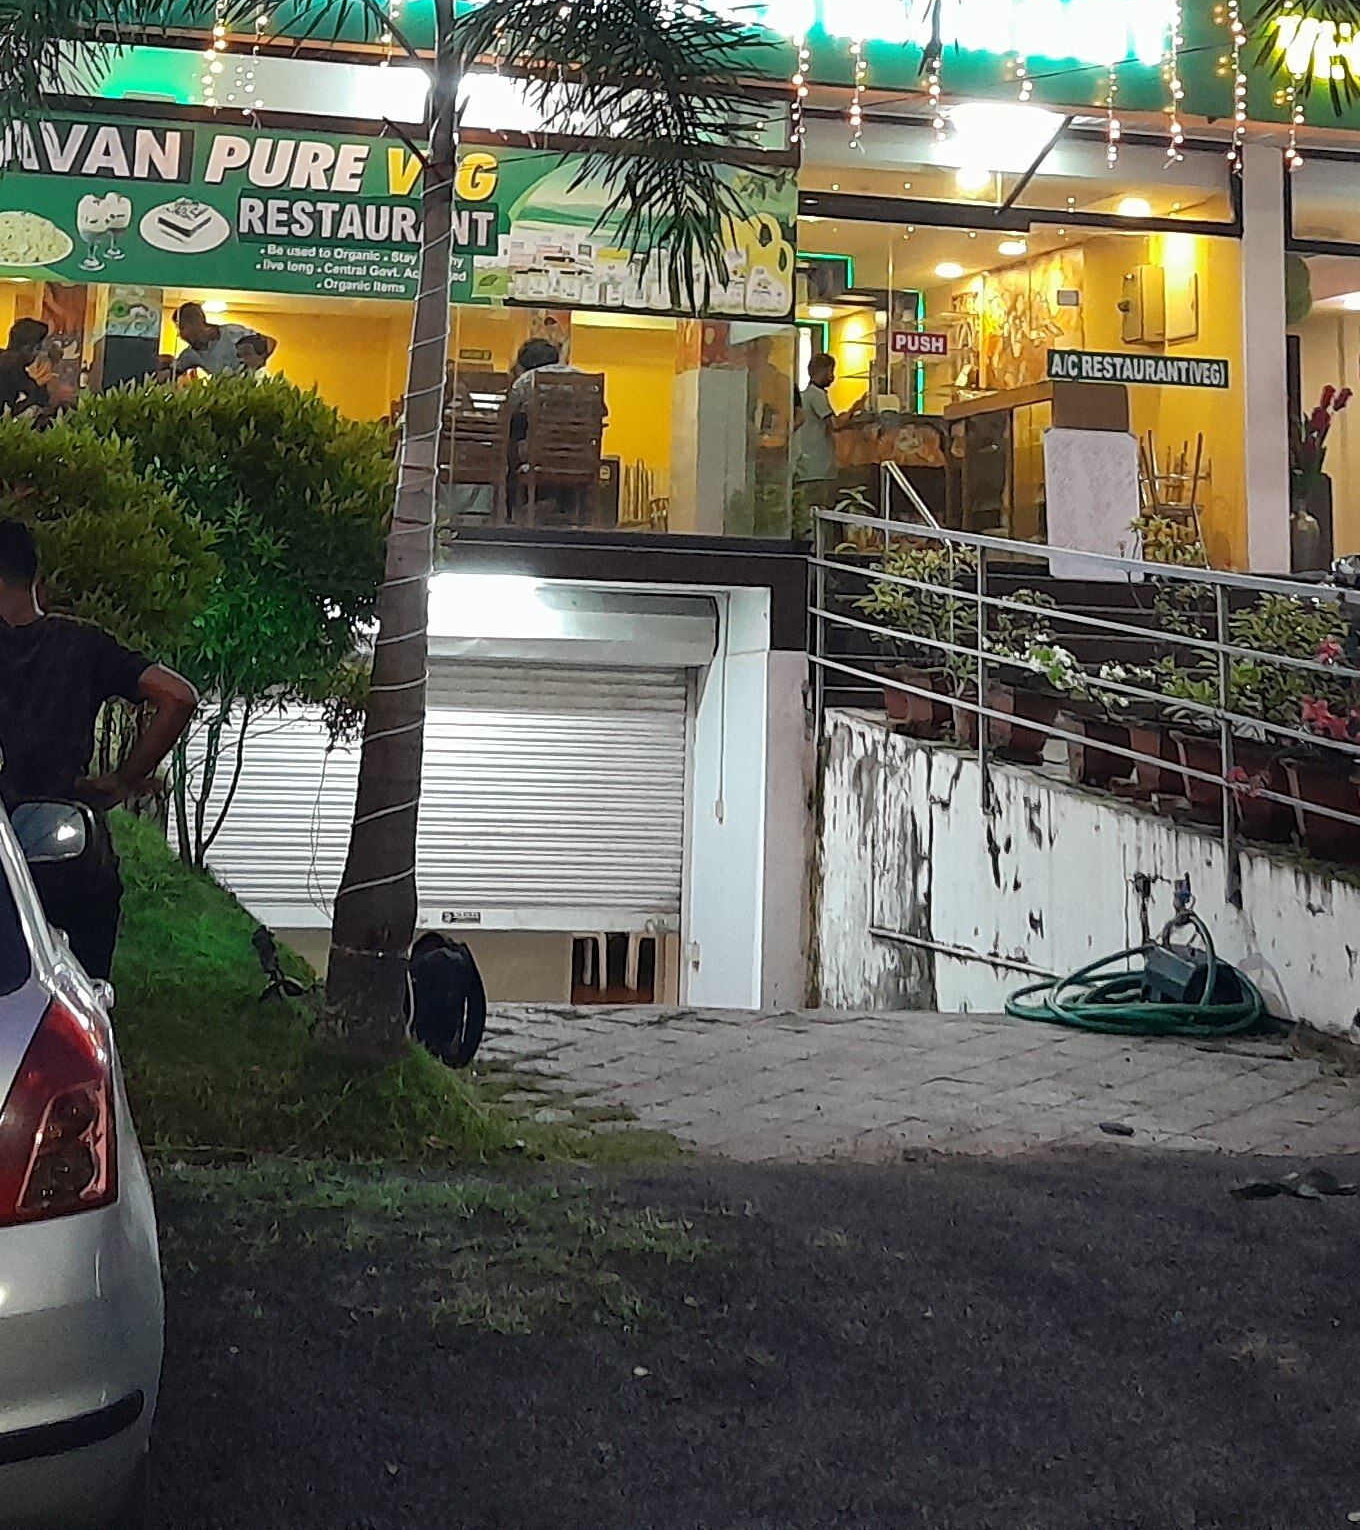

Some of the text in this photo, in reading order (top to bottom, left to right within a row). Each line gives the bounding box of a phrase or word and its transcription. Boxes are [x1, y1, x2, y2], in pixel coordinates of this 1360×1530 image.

[204, 134, 370, 192] PURE
[387, 147, 498, 201] VG
[239, 197, 494, 248] RESTAURNT
[268, 244, 283, 255] Be
[287, 247, 315, 258] used
[319, 248, 331, 259] to
[333, 248, 380, 263] Organic
[287, 261, 314, 276] long
[324, 263, 367, 276] Central
[324, 279, 370, 294] Organic
[895, 334, 944, 353] PUSH
[1052, 353, 1078, 377] A/C
